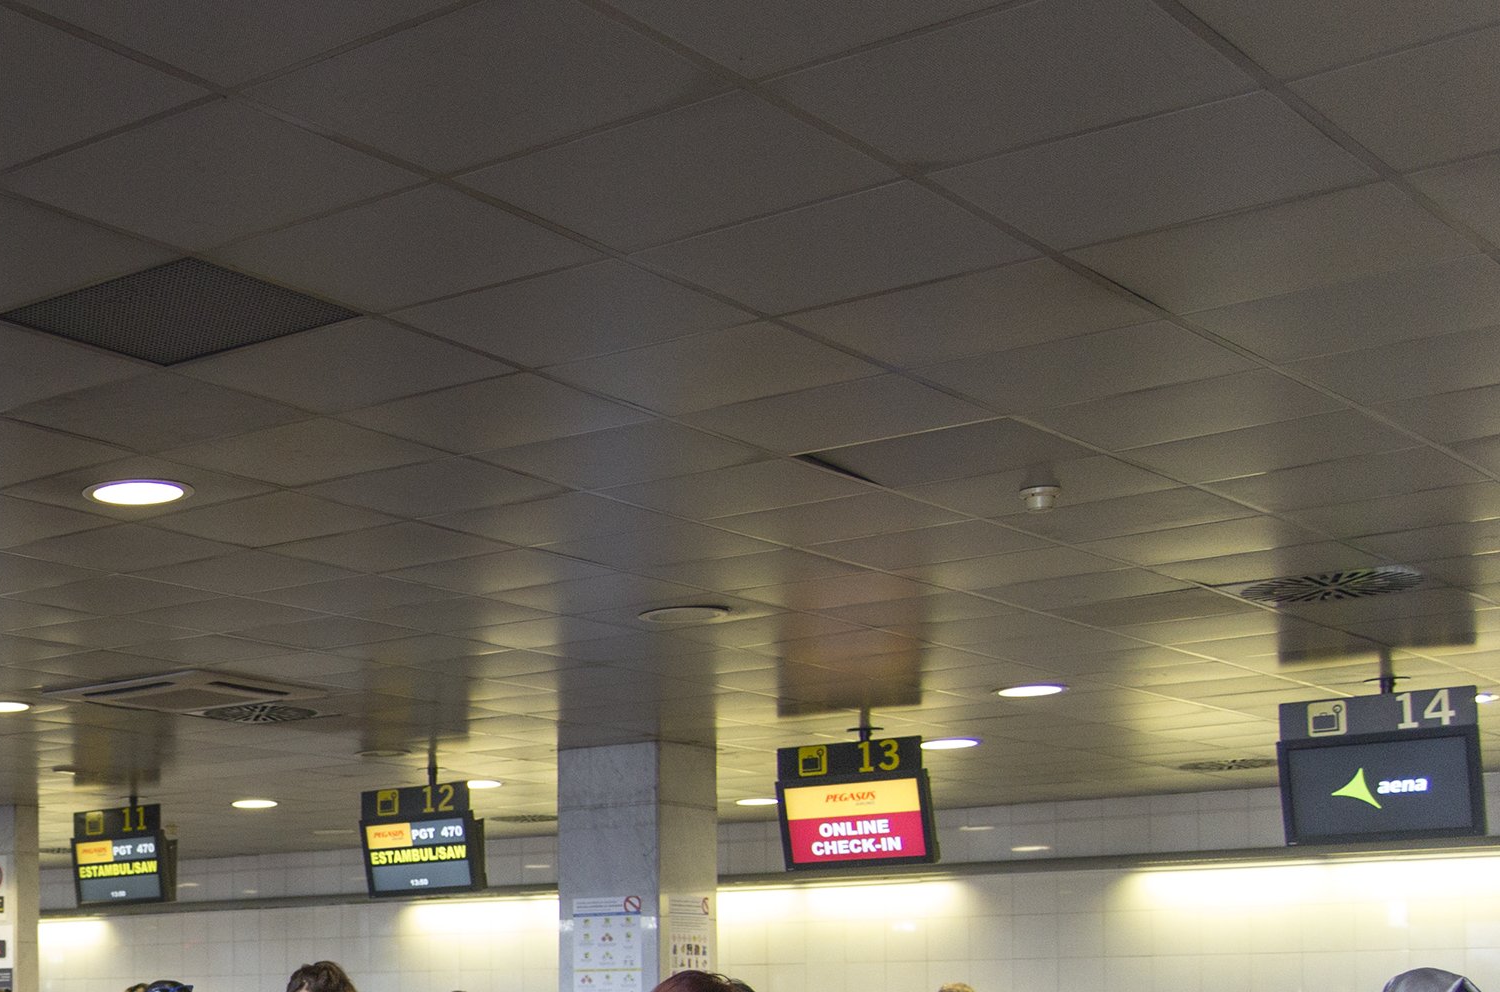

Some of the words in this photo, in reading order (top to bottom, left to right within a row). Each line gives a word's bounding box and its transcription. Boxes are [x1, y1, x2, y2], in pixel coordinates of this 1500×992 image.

[1396, 688, 1456, 730] 14
[857, 738, 900, 773] 13
[1376, 777, 1429, 795] aena
[422, 784, 455, 813] 12
[825, 790, 877, 803] PEGASUS
[121, 806, 147, 832] 11
[818, 818, 891, 838] ONLINE
[411, 828, 436, 840] PGT
[440, 825, 463, 838] 470
[112, 845, 133, 856] PGT
[136, 843, 156, 854] 470
[370, 844, 467, 866] ESTAMBUL/SAW
[810, 836, 903, 856] CHECK-IN
[78, 860, 158, 879] ESTAMBUL/SAW
